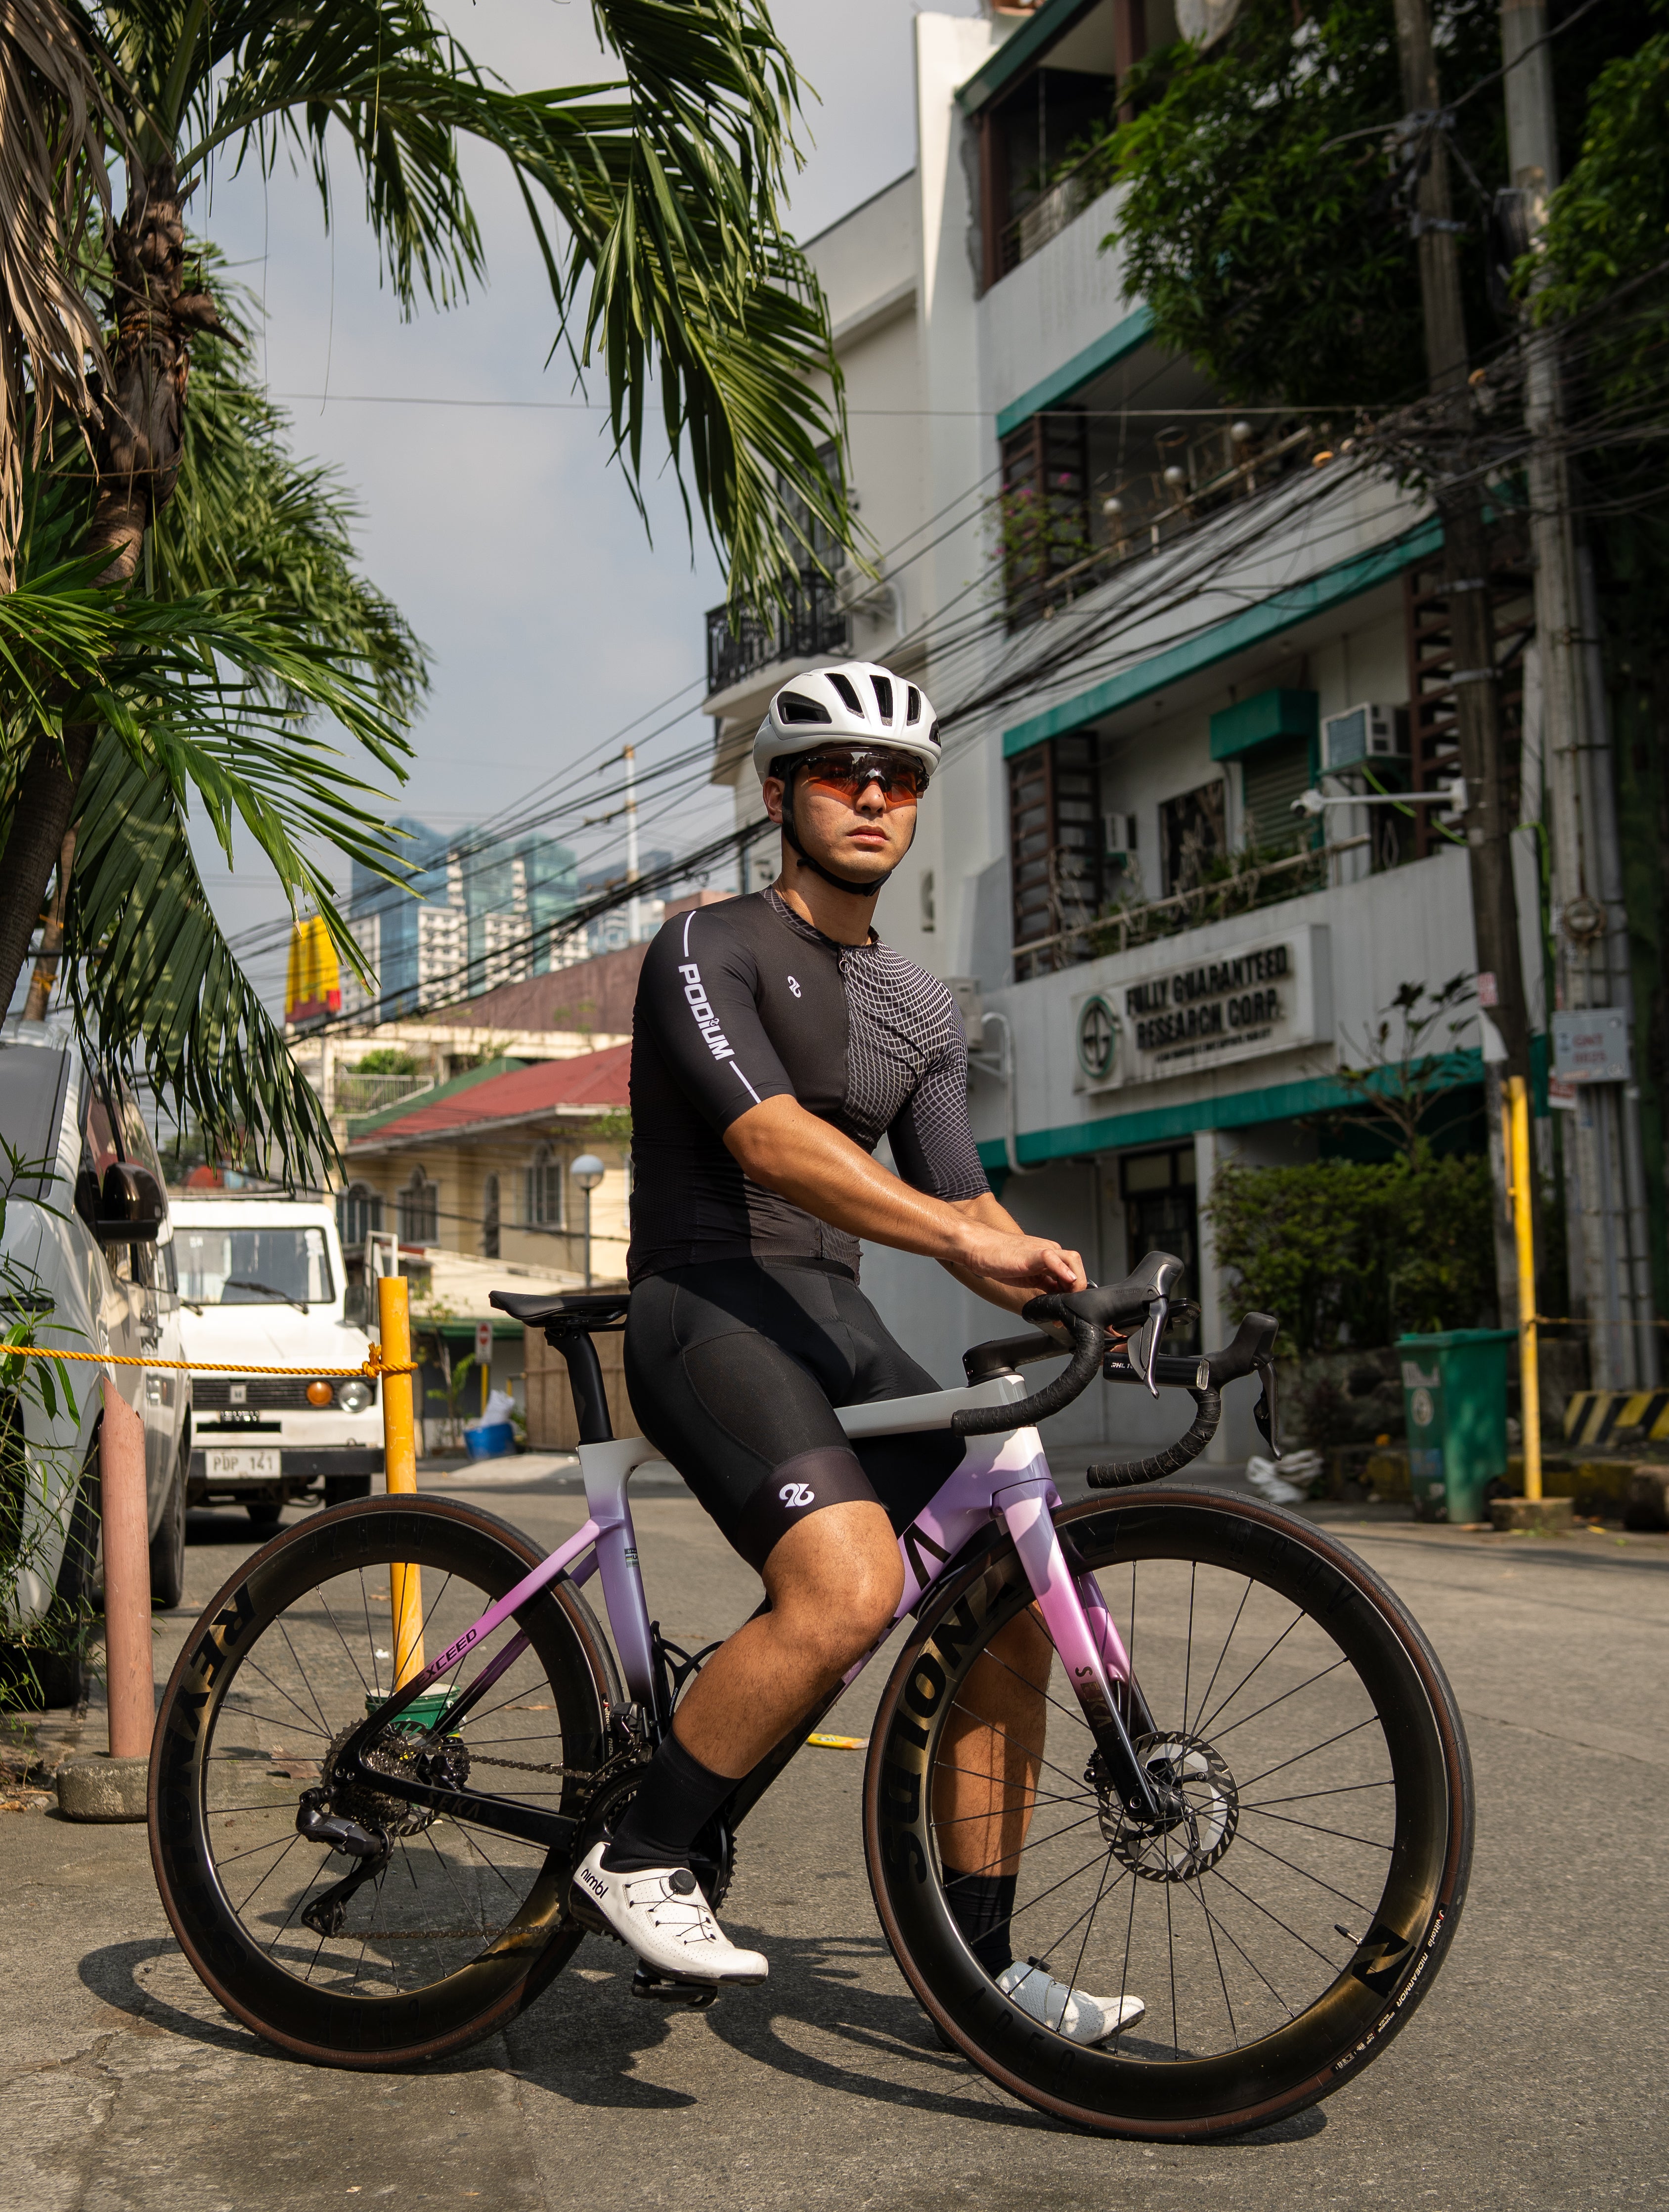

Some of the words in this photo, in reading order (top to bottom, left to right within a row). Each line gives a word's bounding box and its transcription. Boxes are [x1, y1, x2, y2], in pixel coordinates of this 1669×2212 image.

[1125, 979, 1168, 1017] FULLY
[1173, 945, 1287, 1003] GUARANTEED
[1137, 1004, 1222, 1050] RESEARCH
[415, 1628, 478, 1688] EXCEED
[580, 1868, 609, 1900] nimbl
[1427, 1919, 1441, 1947] vittoria
[1396, 1952, 1428, 2007] RIDEARMOR
